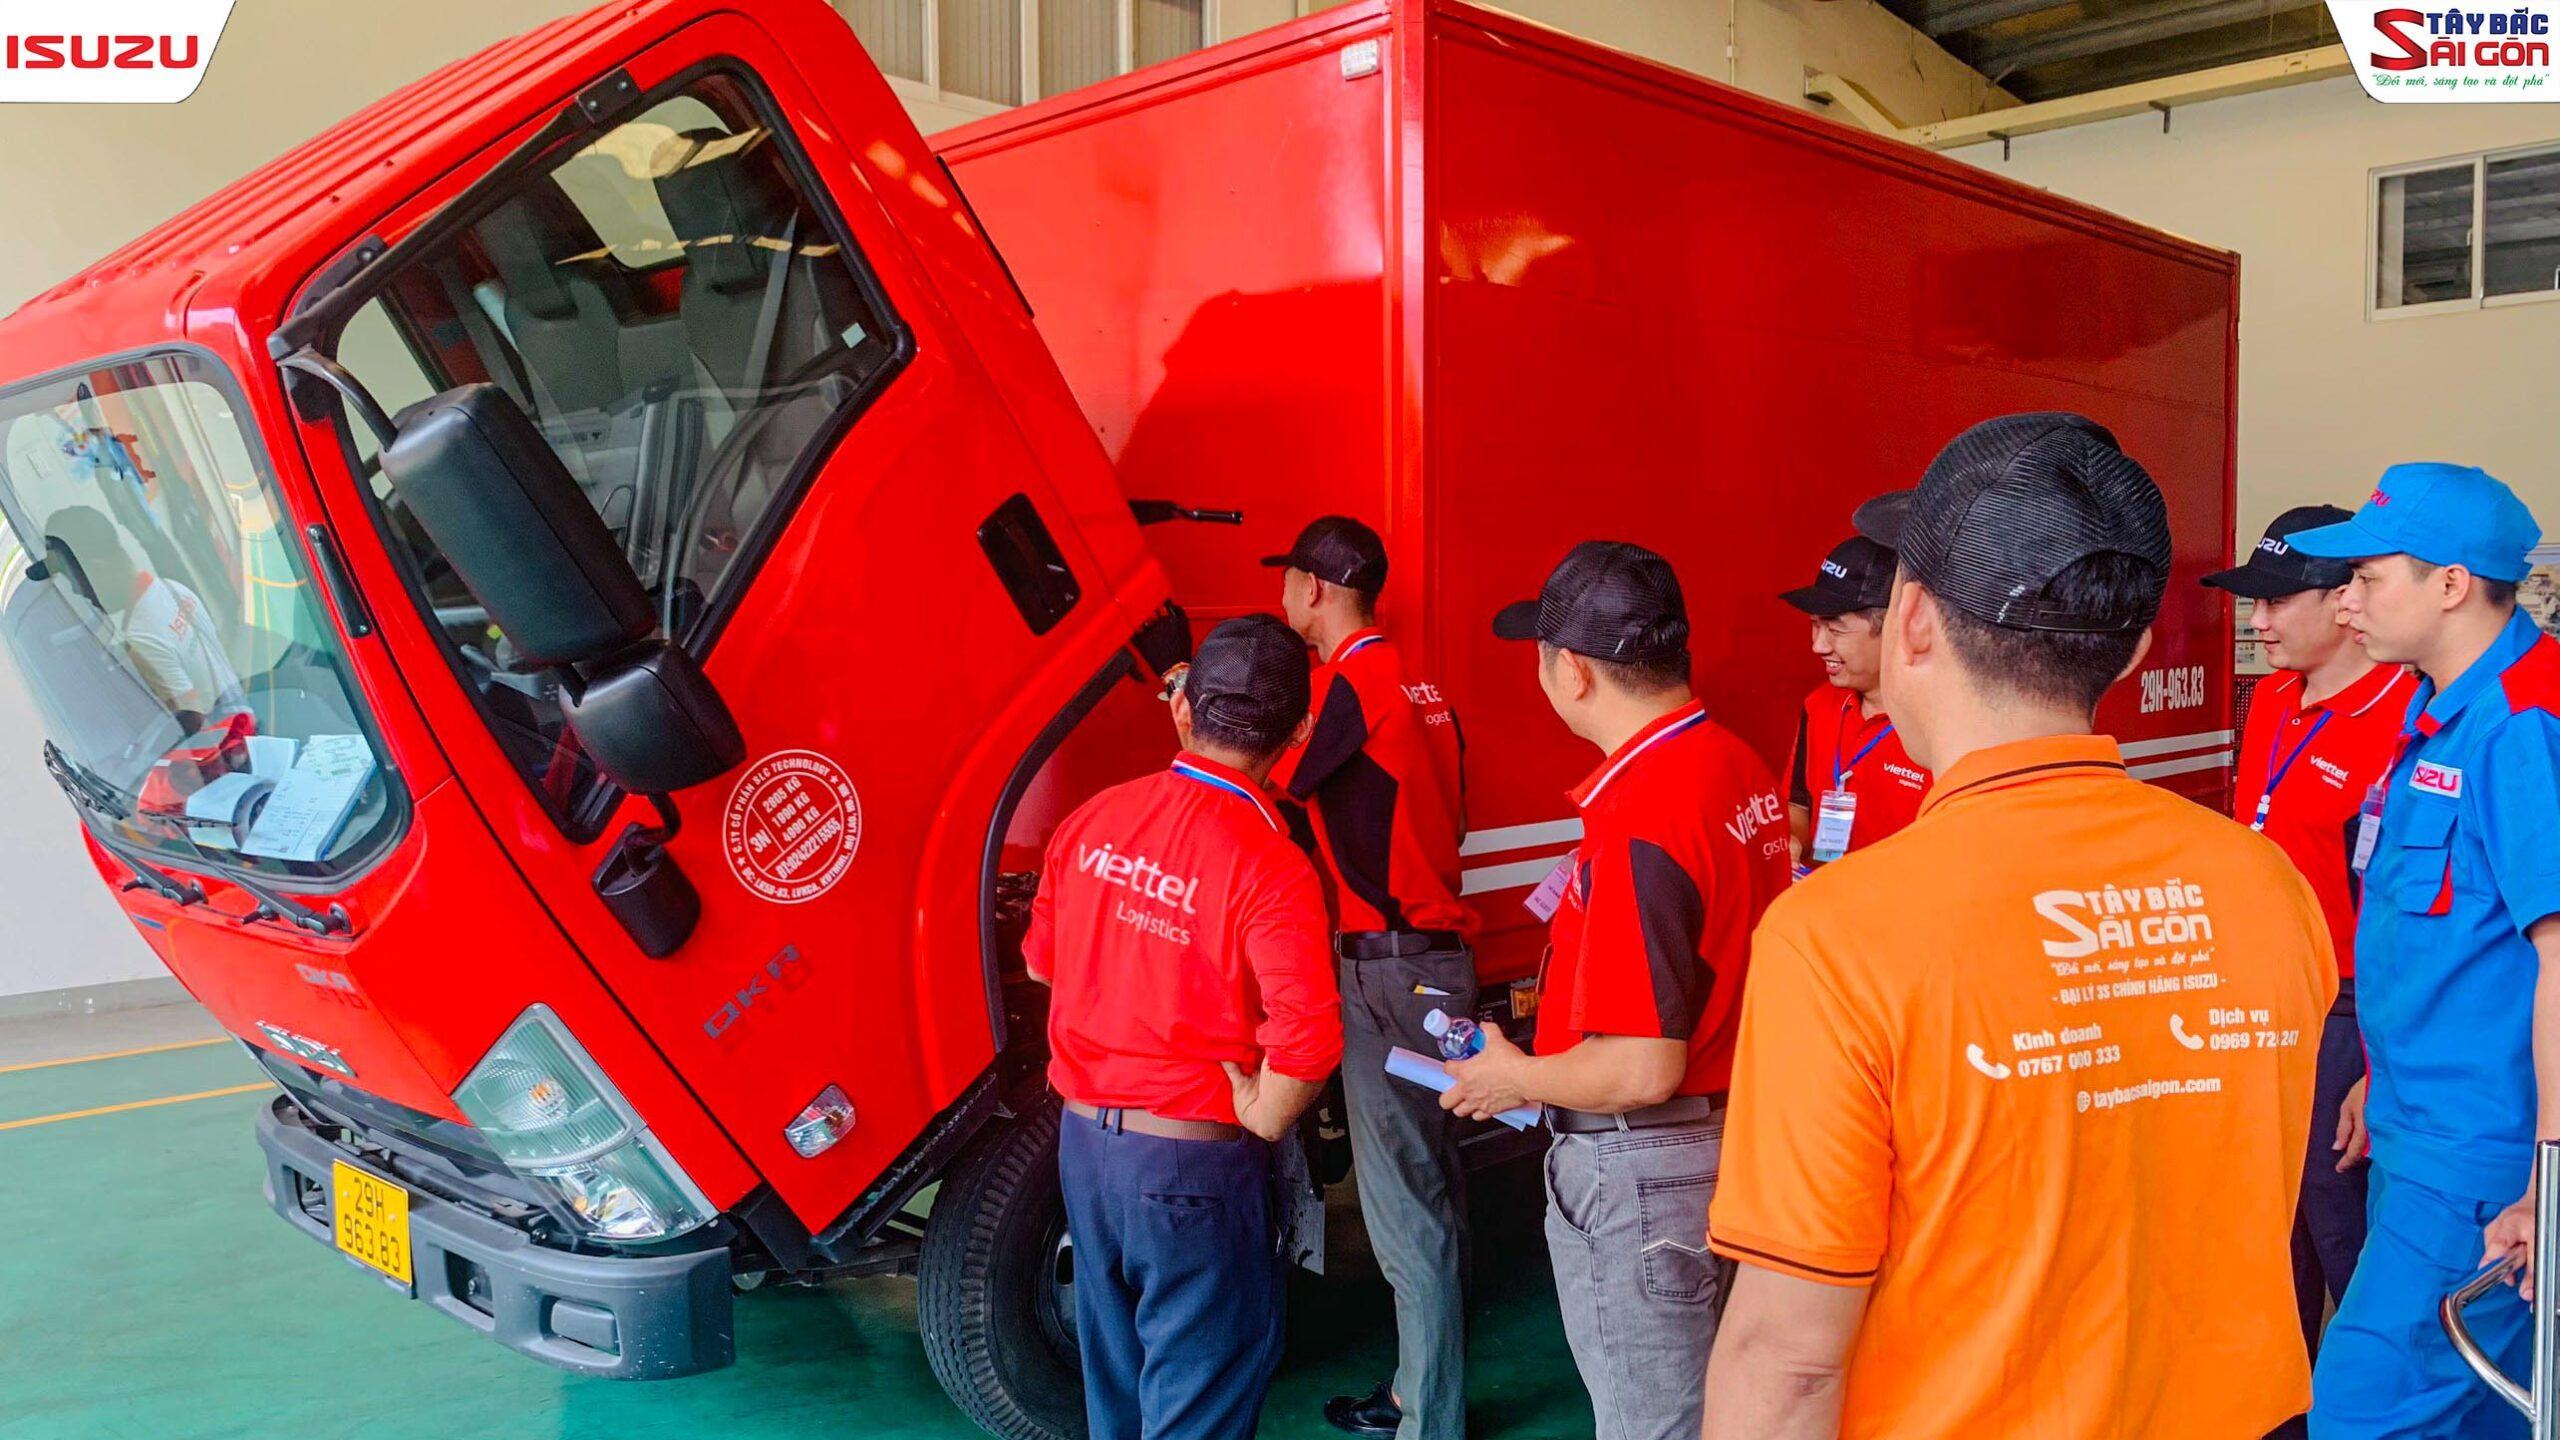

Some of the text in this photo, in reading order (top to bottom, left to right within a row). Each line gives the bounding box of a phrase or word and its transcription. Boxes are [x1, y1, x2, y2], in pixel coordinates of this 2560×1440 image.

[2140, 665, 2205, 714] 29H-963.83
[1883, 763, 1925, 783] viettel
[2310, 754, 2349, 782] viettel
[1077, 843, 1199, 916] viettel
[2084, 877, 2205, 916] TÂY BẮC
[1116, 900, 1191, 945] Logistics
[2183, 972, 2218, 990] ISUZU
[2208, 1006, 2270, 1028] Dịch vụ
[2012, 1022, 2103, 1052] Kinh doanh
[2210, 1031, 2250, 1051] 0969
[2017, 1055, 2063, 1078] 0767
[2096, 1044, 2121, 1065] 333
[2093, 1078, 2221, 1109] taybacsaigon.com
[354, 1176, 386, 1225] 29H
[344, 1212, 401, 1273] 963.83
